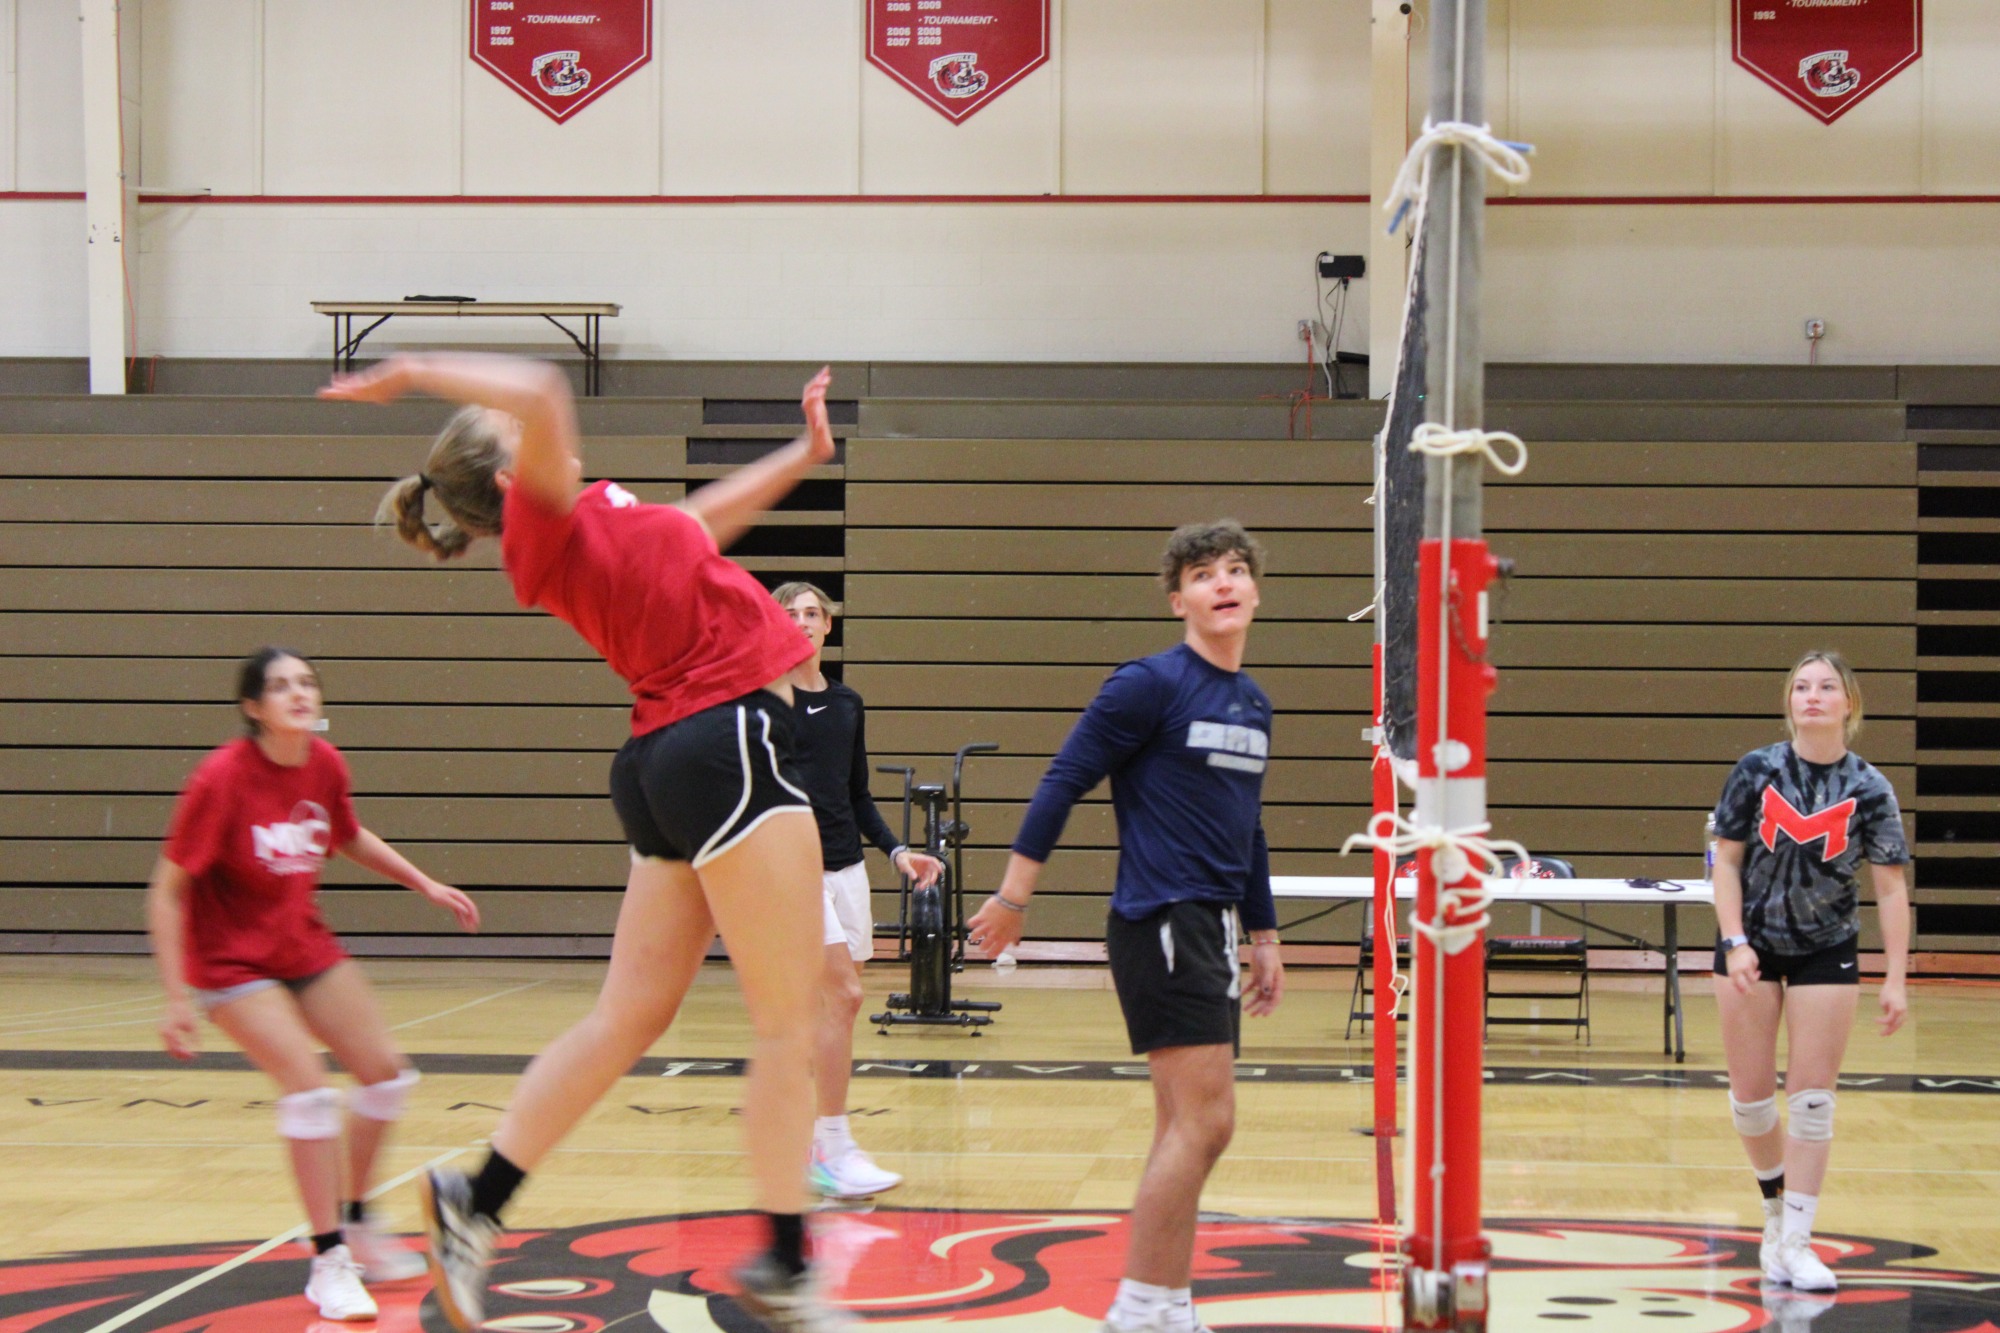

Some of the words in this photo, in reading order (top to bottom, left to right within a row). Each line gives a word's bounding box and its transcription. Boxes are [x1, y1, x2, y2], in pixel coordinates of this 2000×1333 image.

[491, 2, 514, 11] 2004
[526, 15, 596, 24] TOURNAMENT
[923, 16, 993, 25] TOURNAMENT
